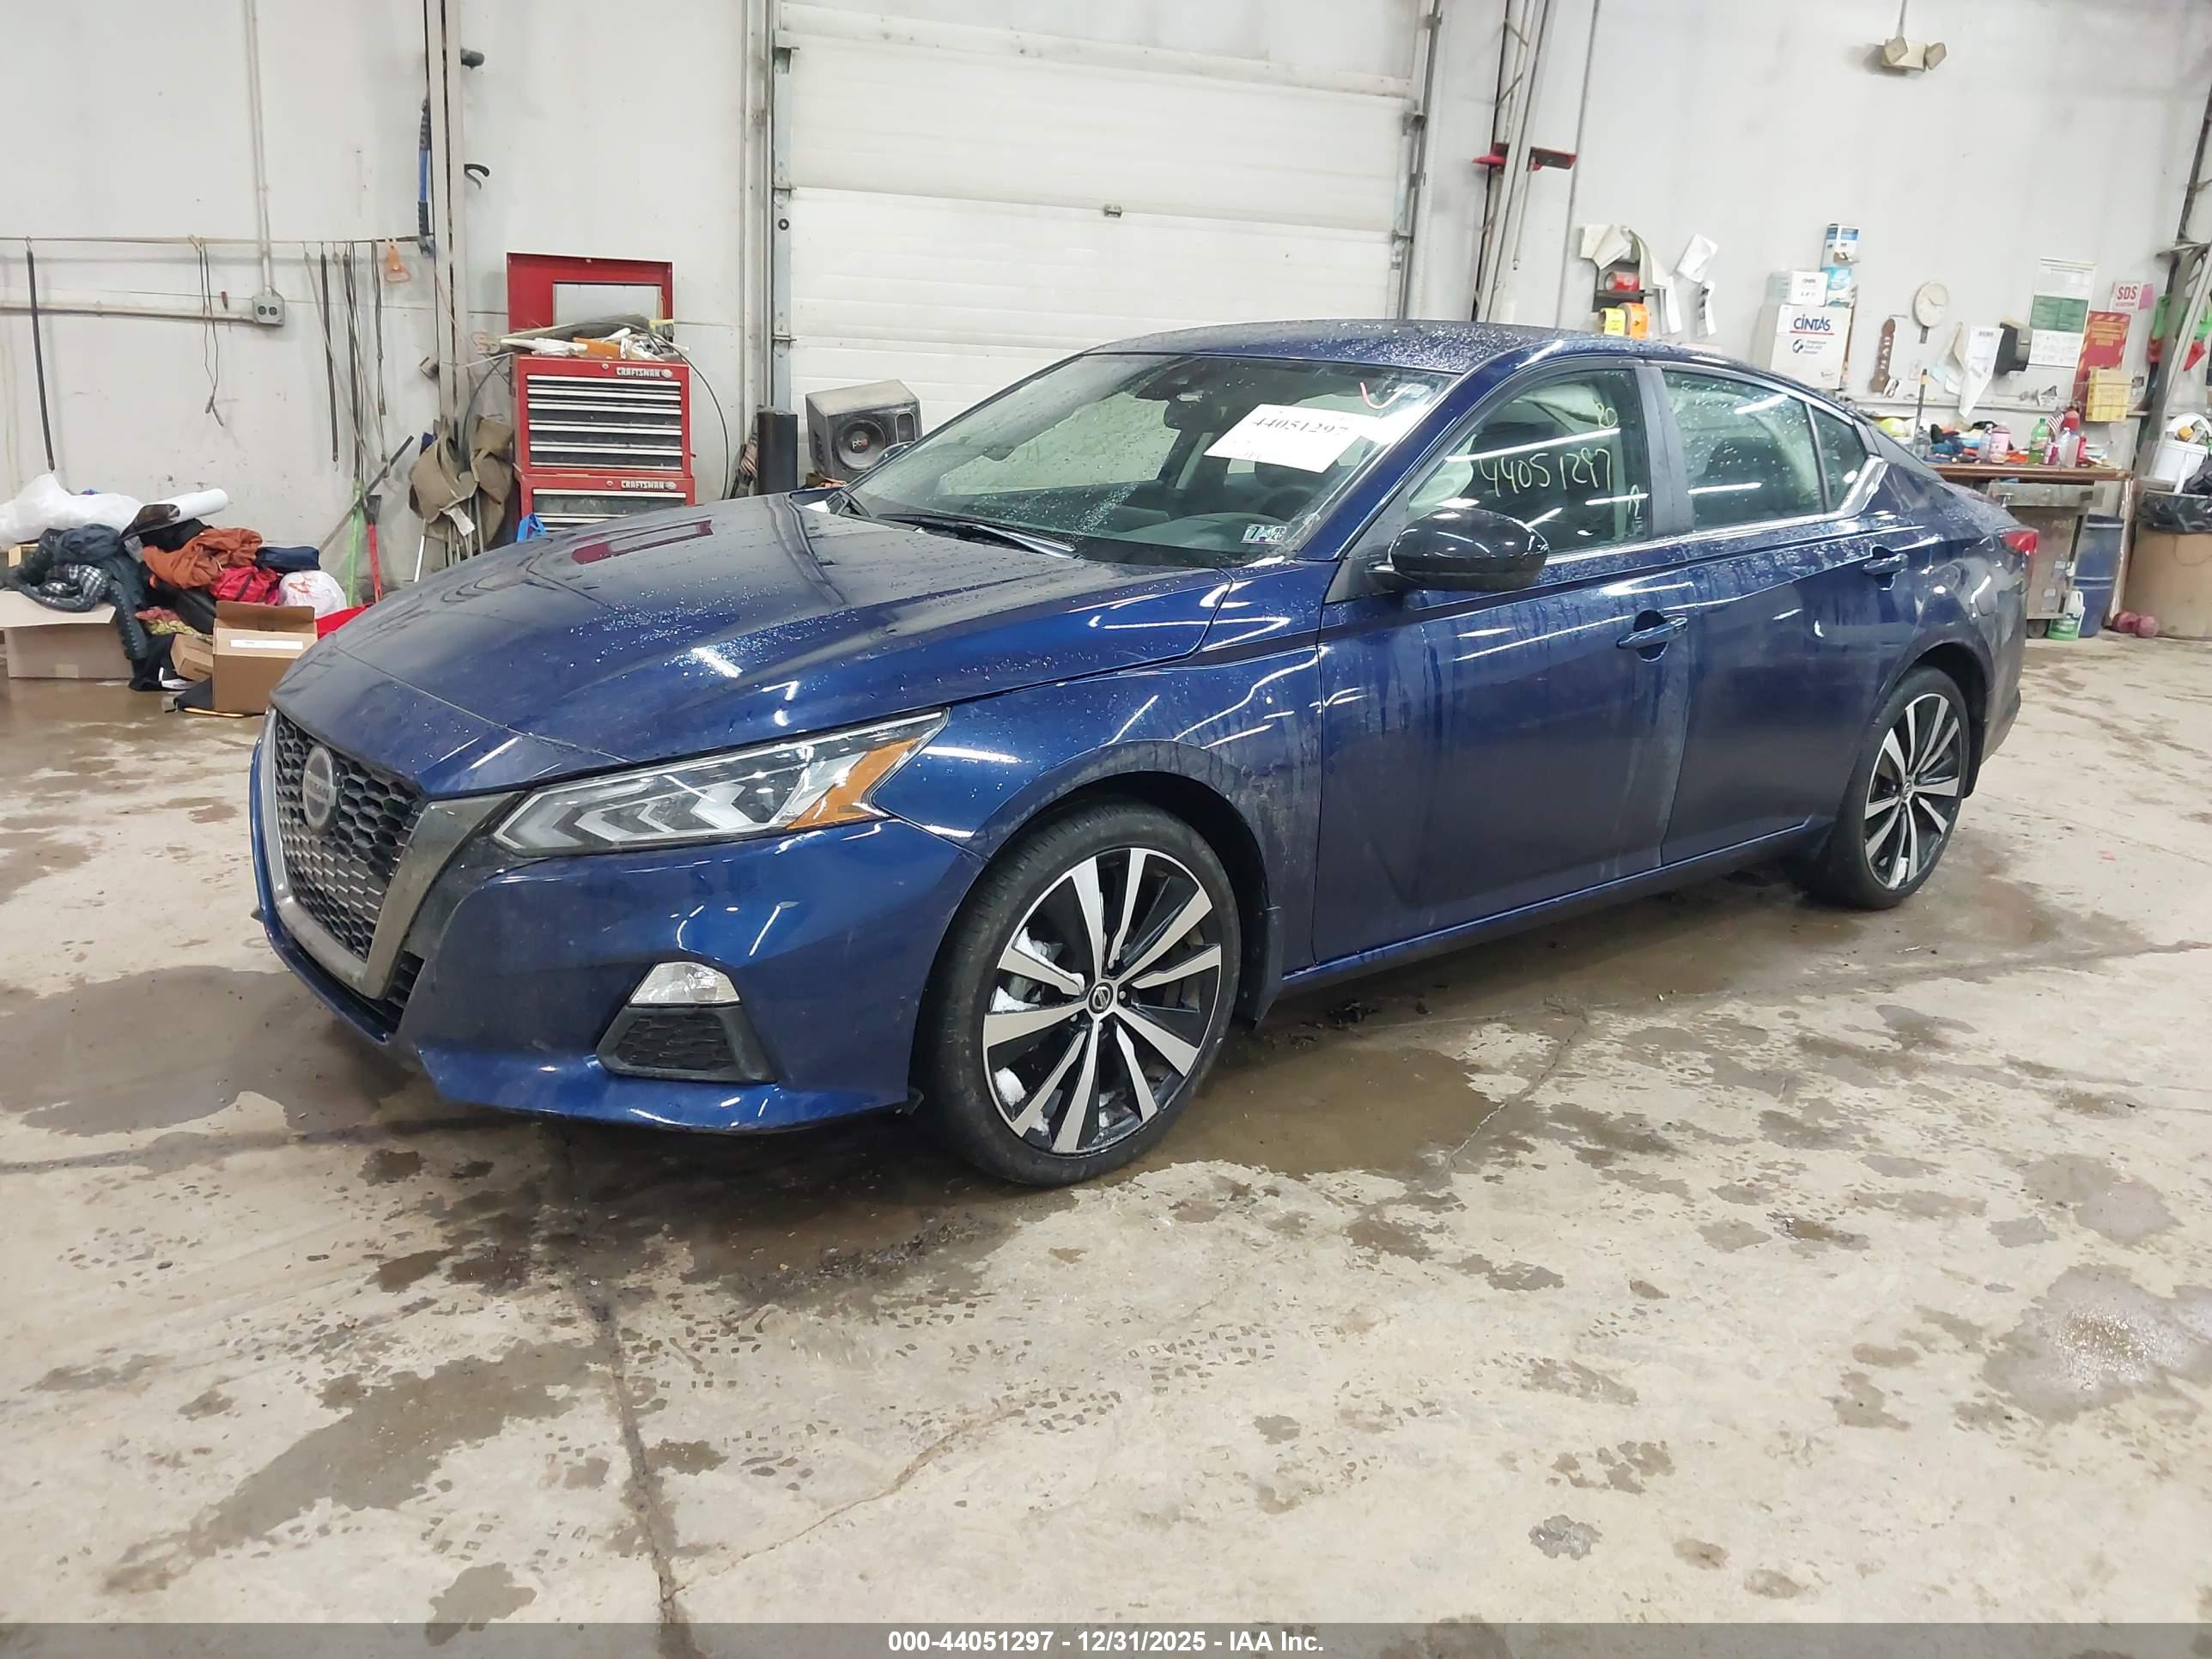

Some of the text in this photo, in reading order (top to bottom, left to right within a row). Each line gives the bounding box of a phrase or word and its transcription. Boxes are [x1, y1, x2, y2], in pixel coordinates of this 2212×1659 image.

[2117, 286, 2138, 301] SDS
[617, 367, 661, 378] CRAFTSMAN
[1253, 417, 1349, 434] 44051297
[621, 480, 665, 490] CRAFTSMAN
